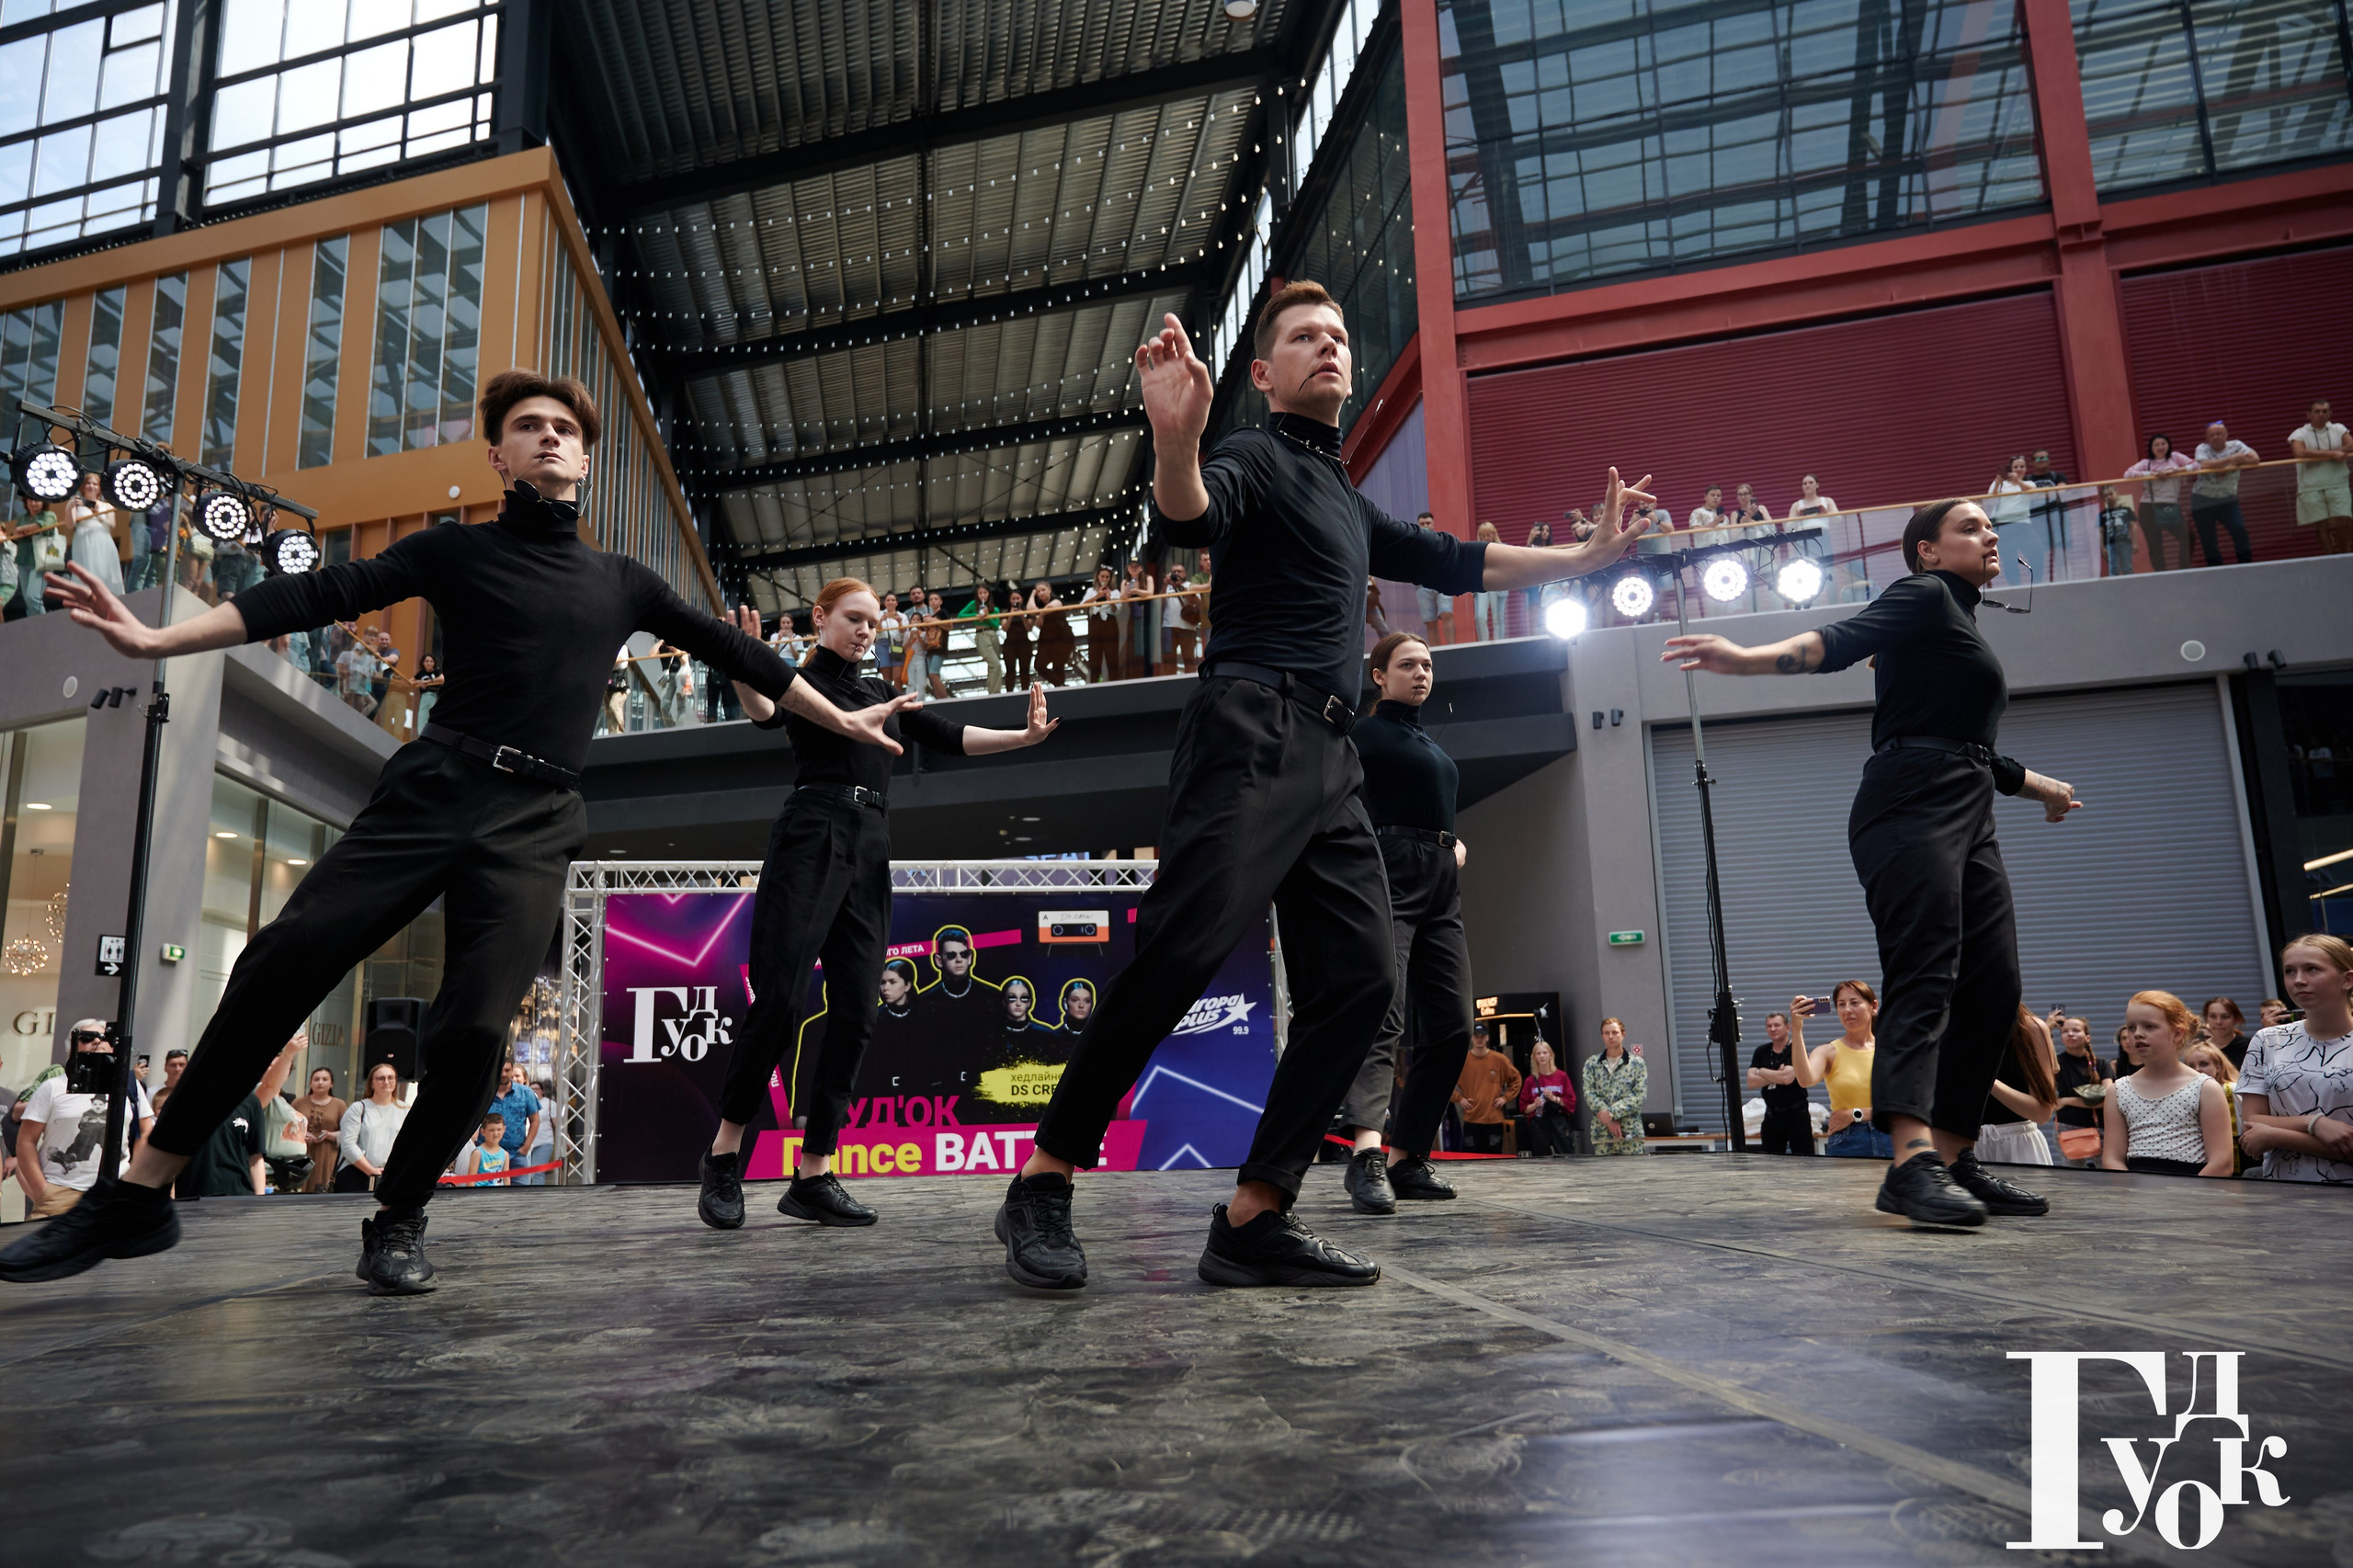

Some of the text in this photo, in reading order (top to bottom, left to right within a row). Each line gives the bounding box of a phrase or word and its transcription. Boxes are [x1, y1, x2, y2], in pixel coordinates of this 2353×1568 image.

[886, 944, 925, 957] ГО ЛЕТА
[13, 1010, 56, 1036] GI
[1233, 1026, 1249, 1035] 99.9
[313, 1022, 345, 1047] GIZIA
[1011, 1084, 1059, 1096] DS CRE
[847, 1095, 961, 1129] УД'ОК
